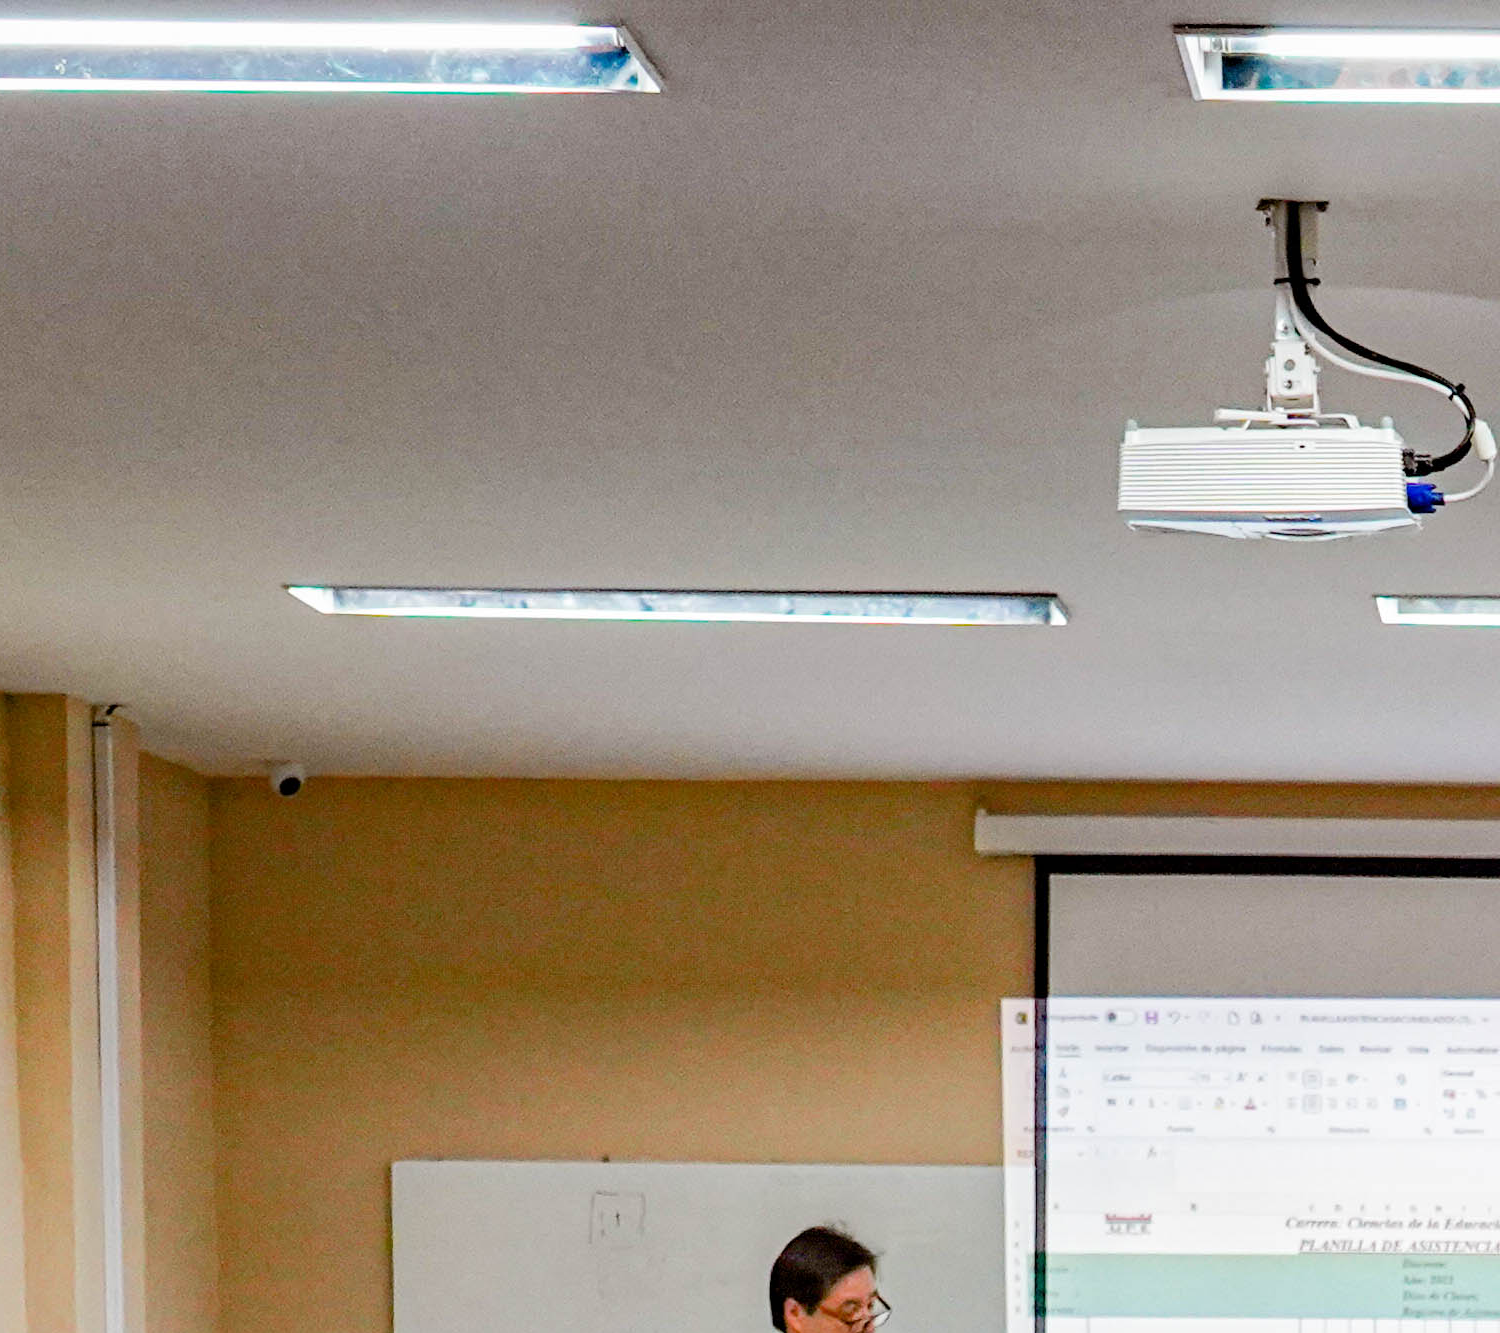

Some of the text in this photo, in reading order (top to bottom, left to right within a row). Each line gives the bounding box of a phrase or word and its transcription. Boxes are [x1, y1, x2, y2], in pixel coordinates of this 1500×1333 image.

[1348, 1218, 1403, 1230] Ciencias
[1409, 1218, 1422, 1230] de
[1427, 1218, 1439, 1230] la
[1300, 1239, 1500, 1253] PLANILLA DE ASISTENCIA
